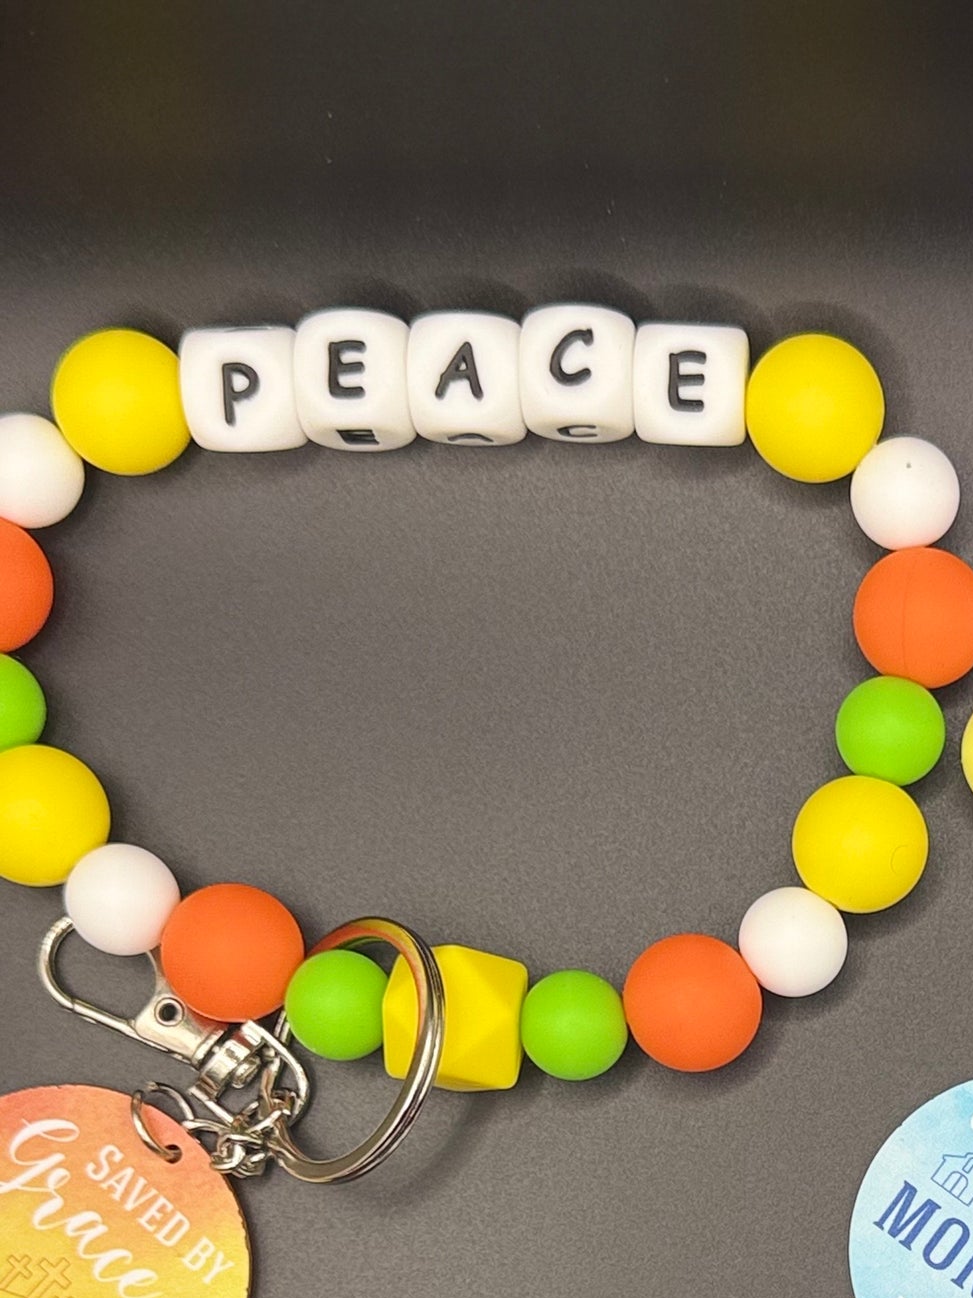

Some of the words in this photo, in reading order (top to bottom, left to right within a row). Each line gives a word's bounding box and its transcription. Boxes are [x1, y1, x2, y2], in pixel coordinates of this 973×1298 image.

[221, 328, 708, 426] PEACE
[86, 1144, 191, 1247] SAVED
[181, 1237, 235, 1285] BY
